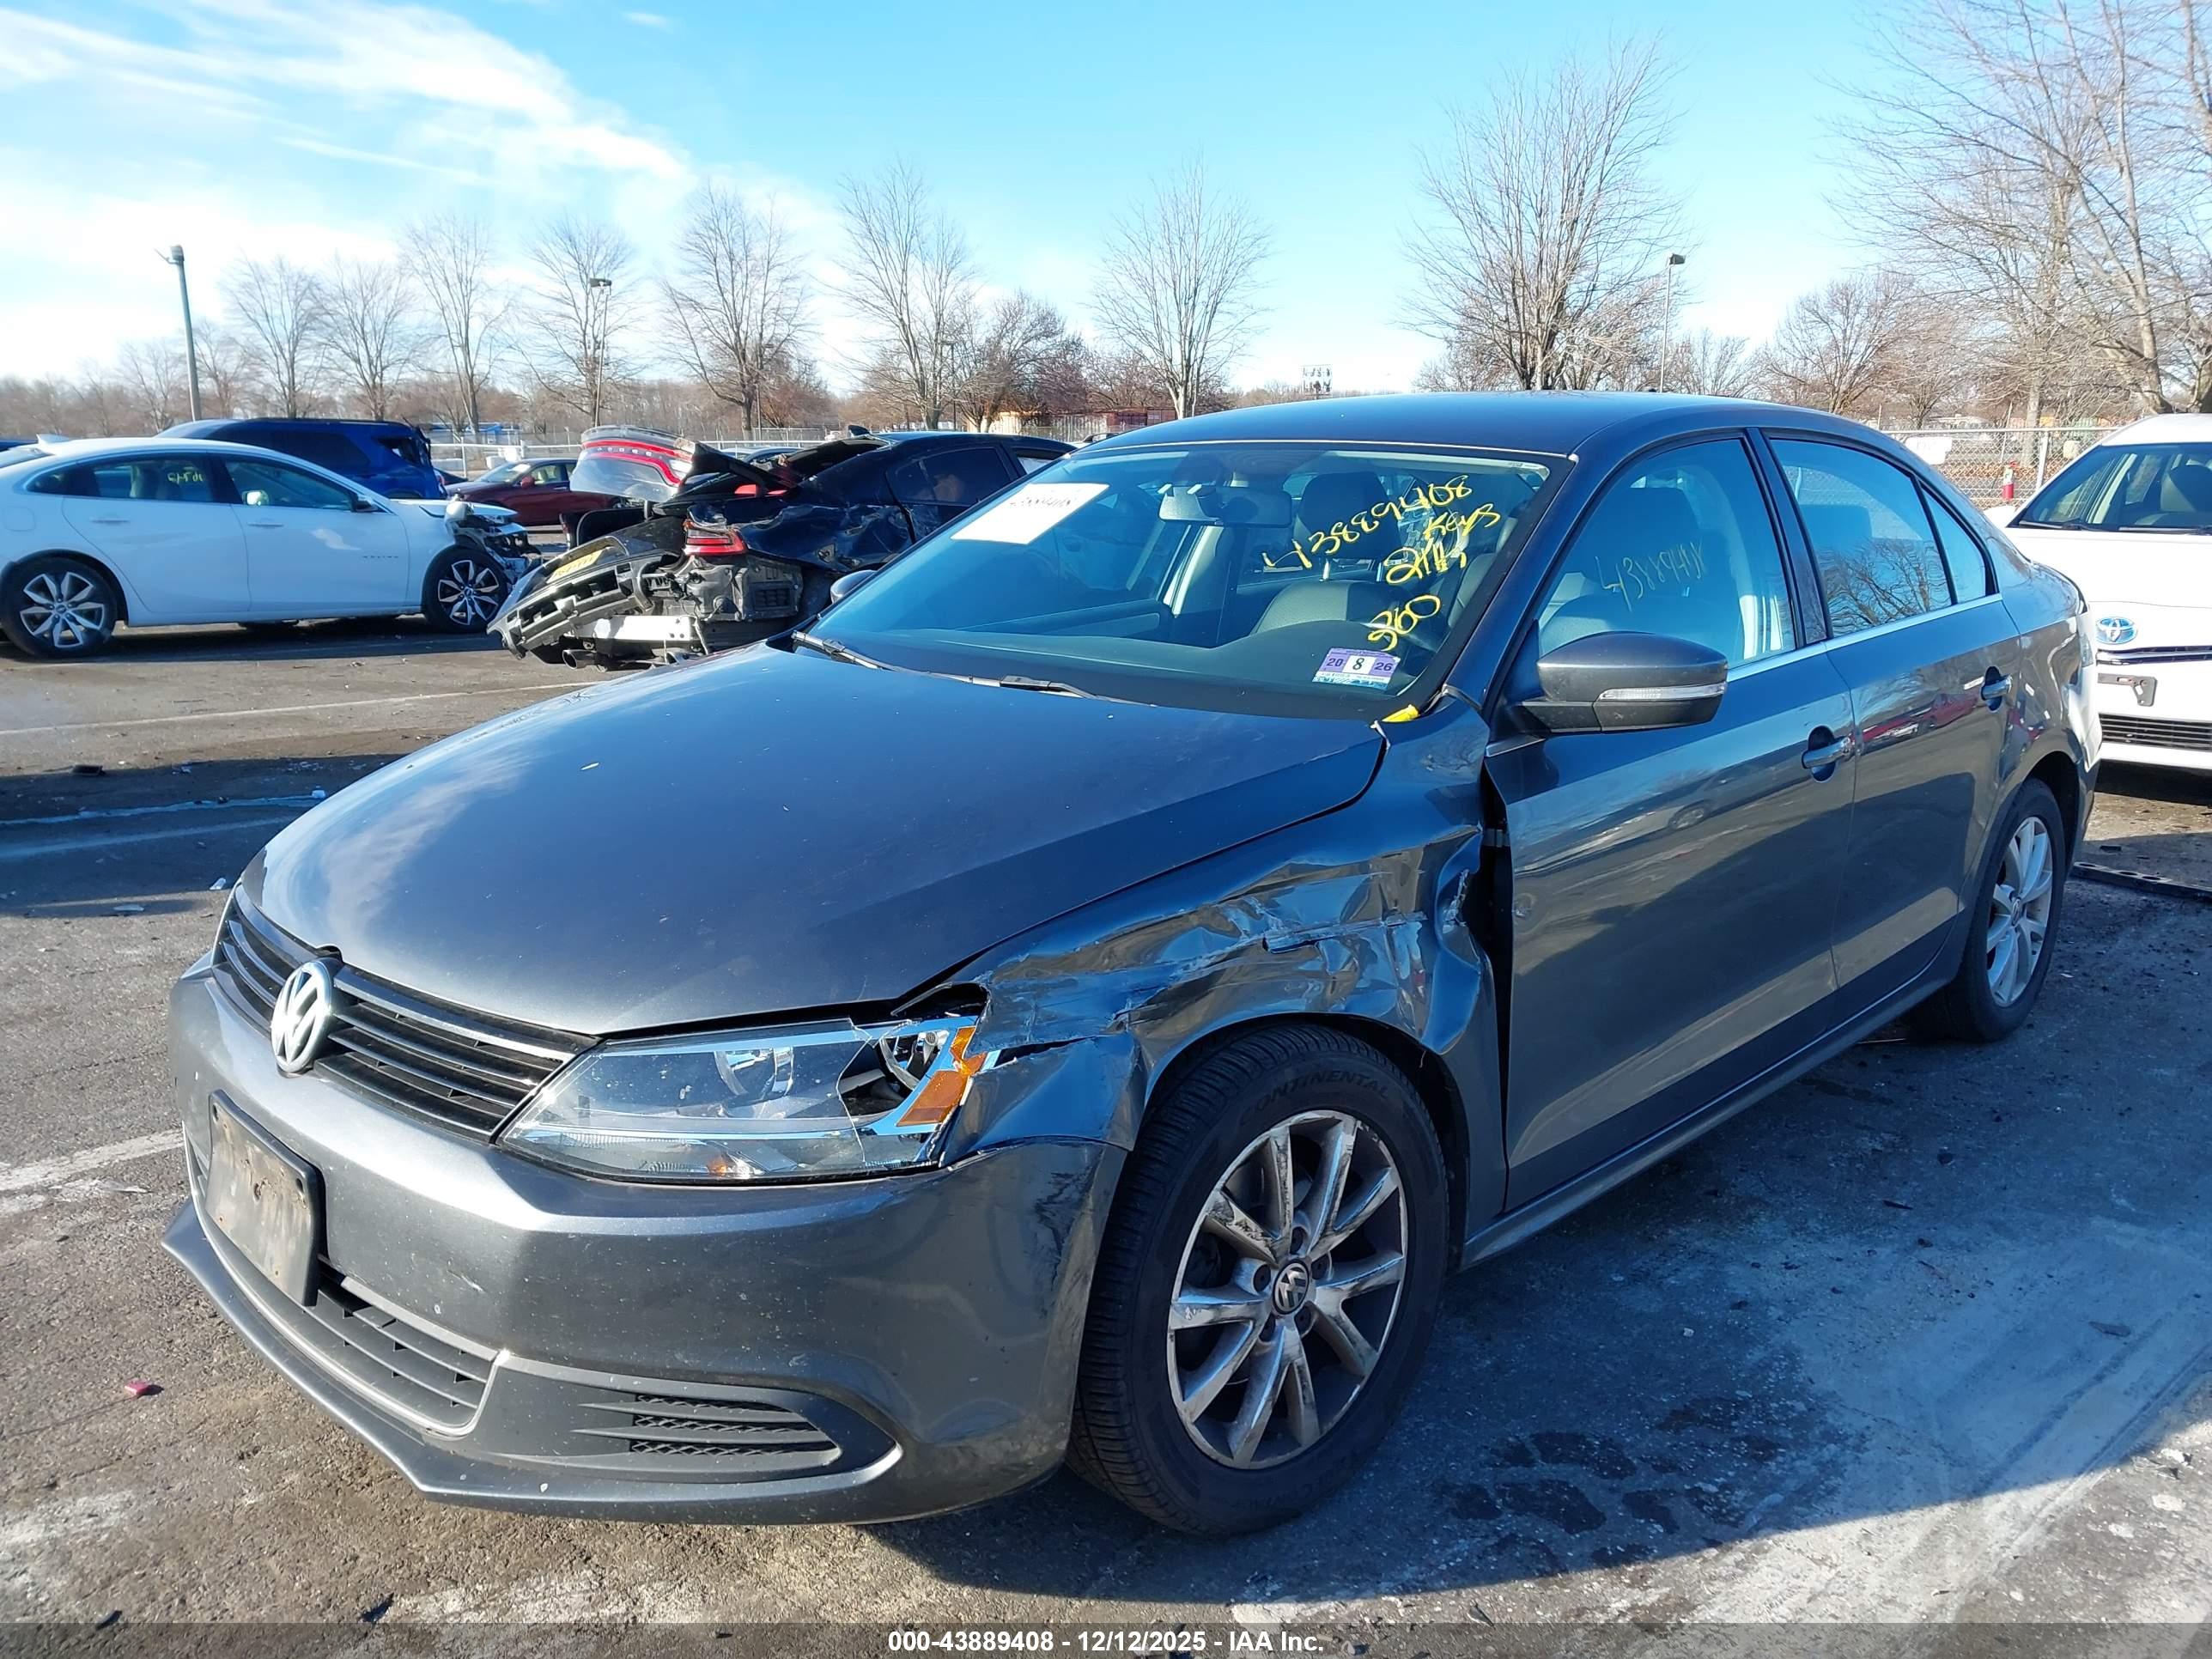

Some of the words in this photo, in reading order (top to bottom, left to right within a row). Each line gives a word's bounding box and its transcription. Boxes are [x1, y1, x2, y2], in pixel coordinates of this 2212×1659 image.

[1261, 475, 1473, 569] 43889408
[1326, 658, 1344, 668] 20
[1352, 657, 1365, 671] 8
[1374, 661, 1393, 672] 26
